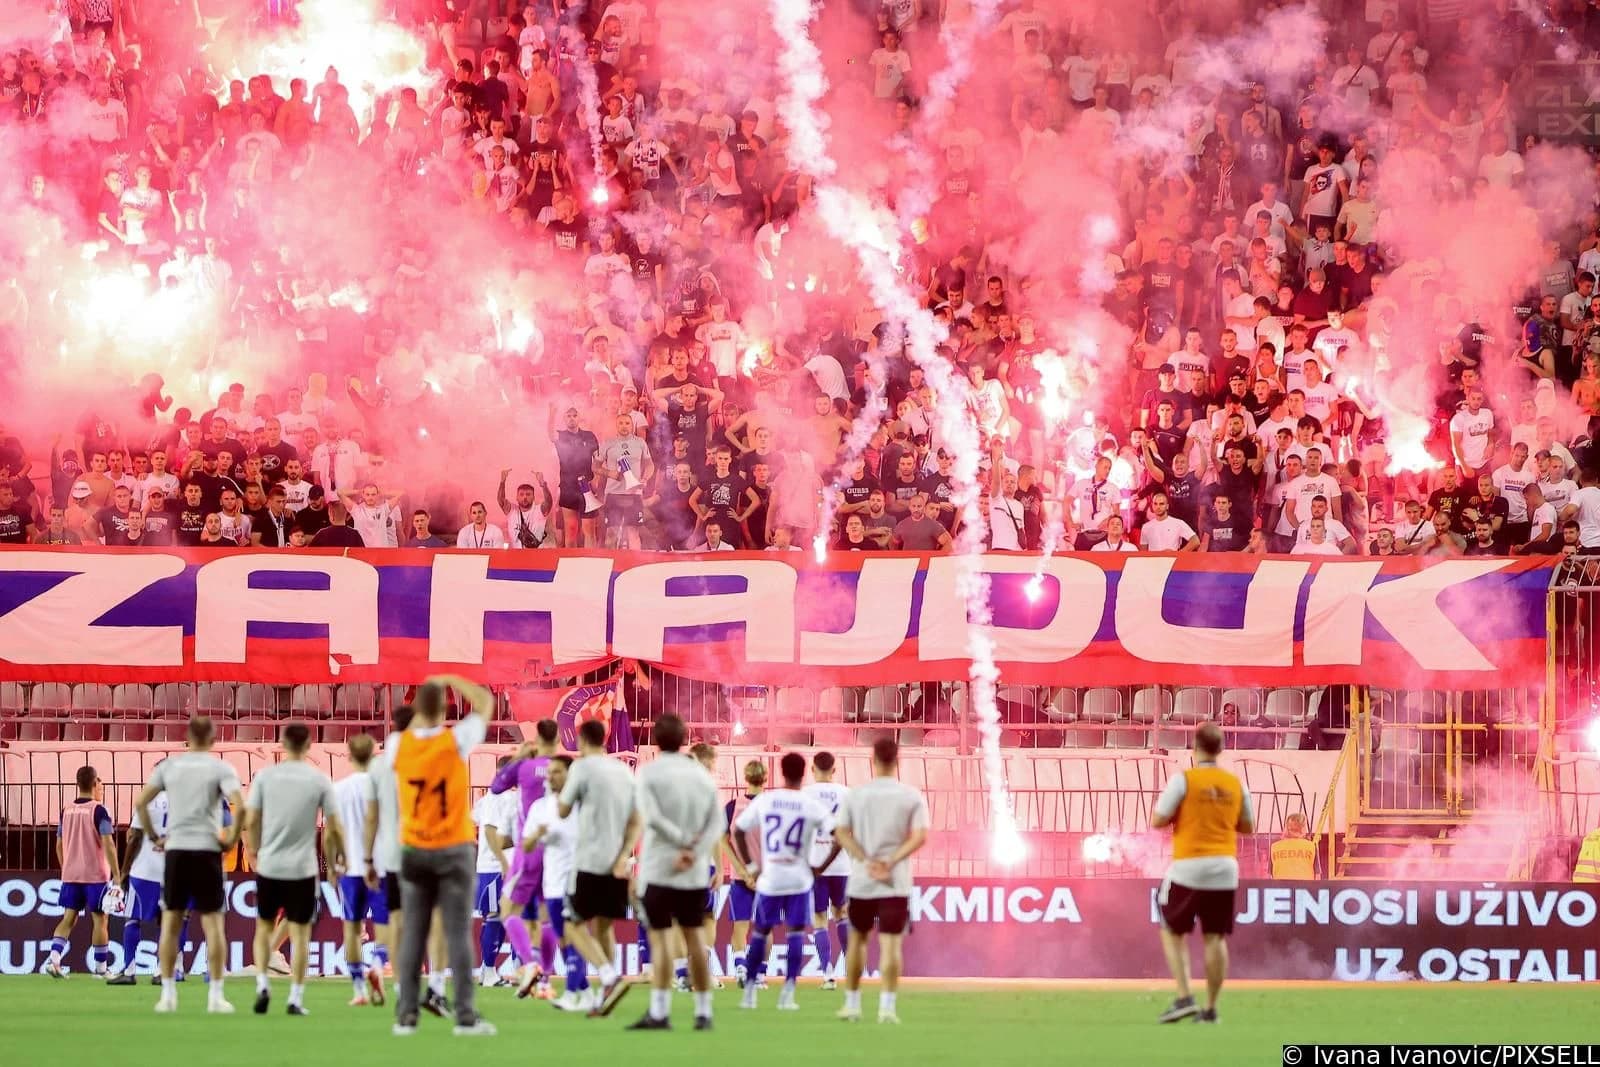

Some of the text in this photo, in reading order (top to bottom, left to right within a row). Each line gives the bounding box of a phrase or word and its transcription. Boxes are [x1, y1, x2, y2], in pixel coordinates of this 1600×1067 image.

[0, 553, 1516, 672] ZA HAJDUK
[407, 777, 447, 820] 71
[765, 813, 805, 856] 24
[1435, 882, 1597, 927] UŽIVO
[1334, 947, 1597, 982] UZ OSTALI
